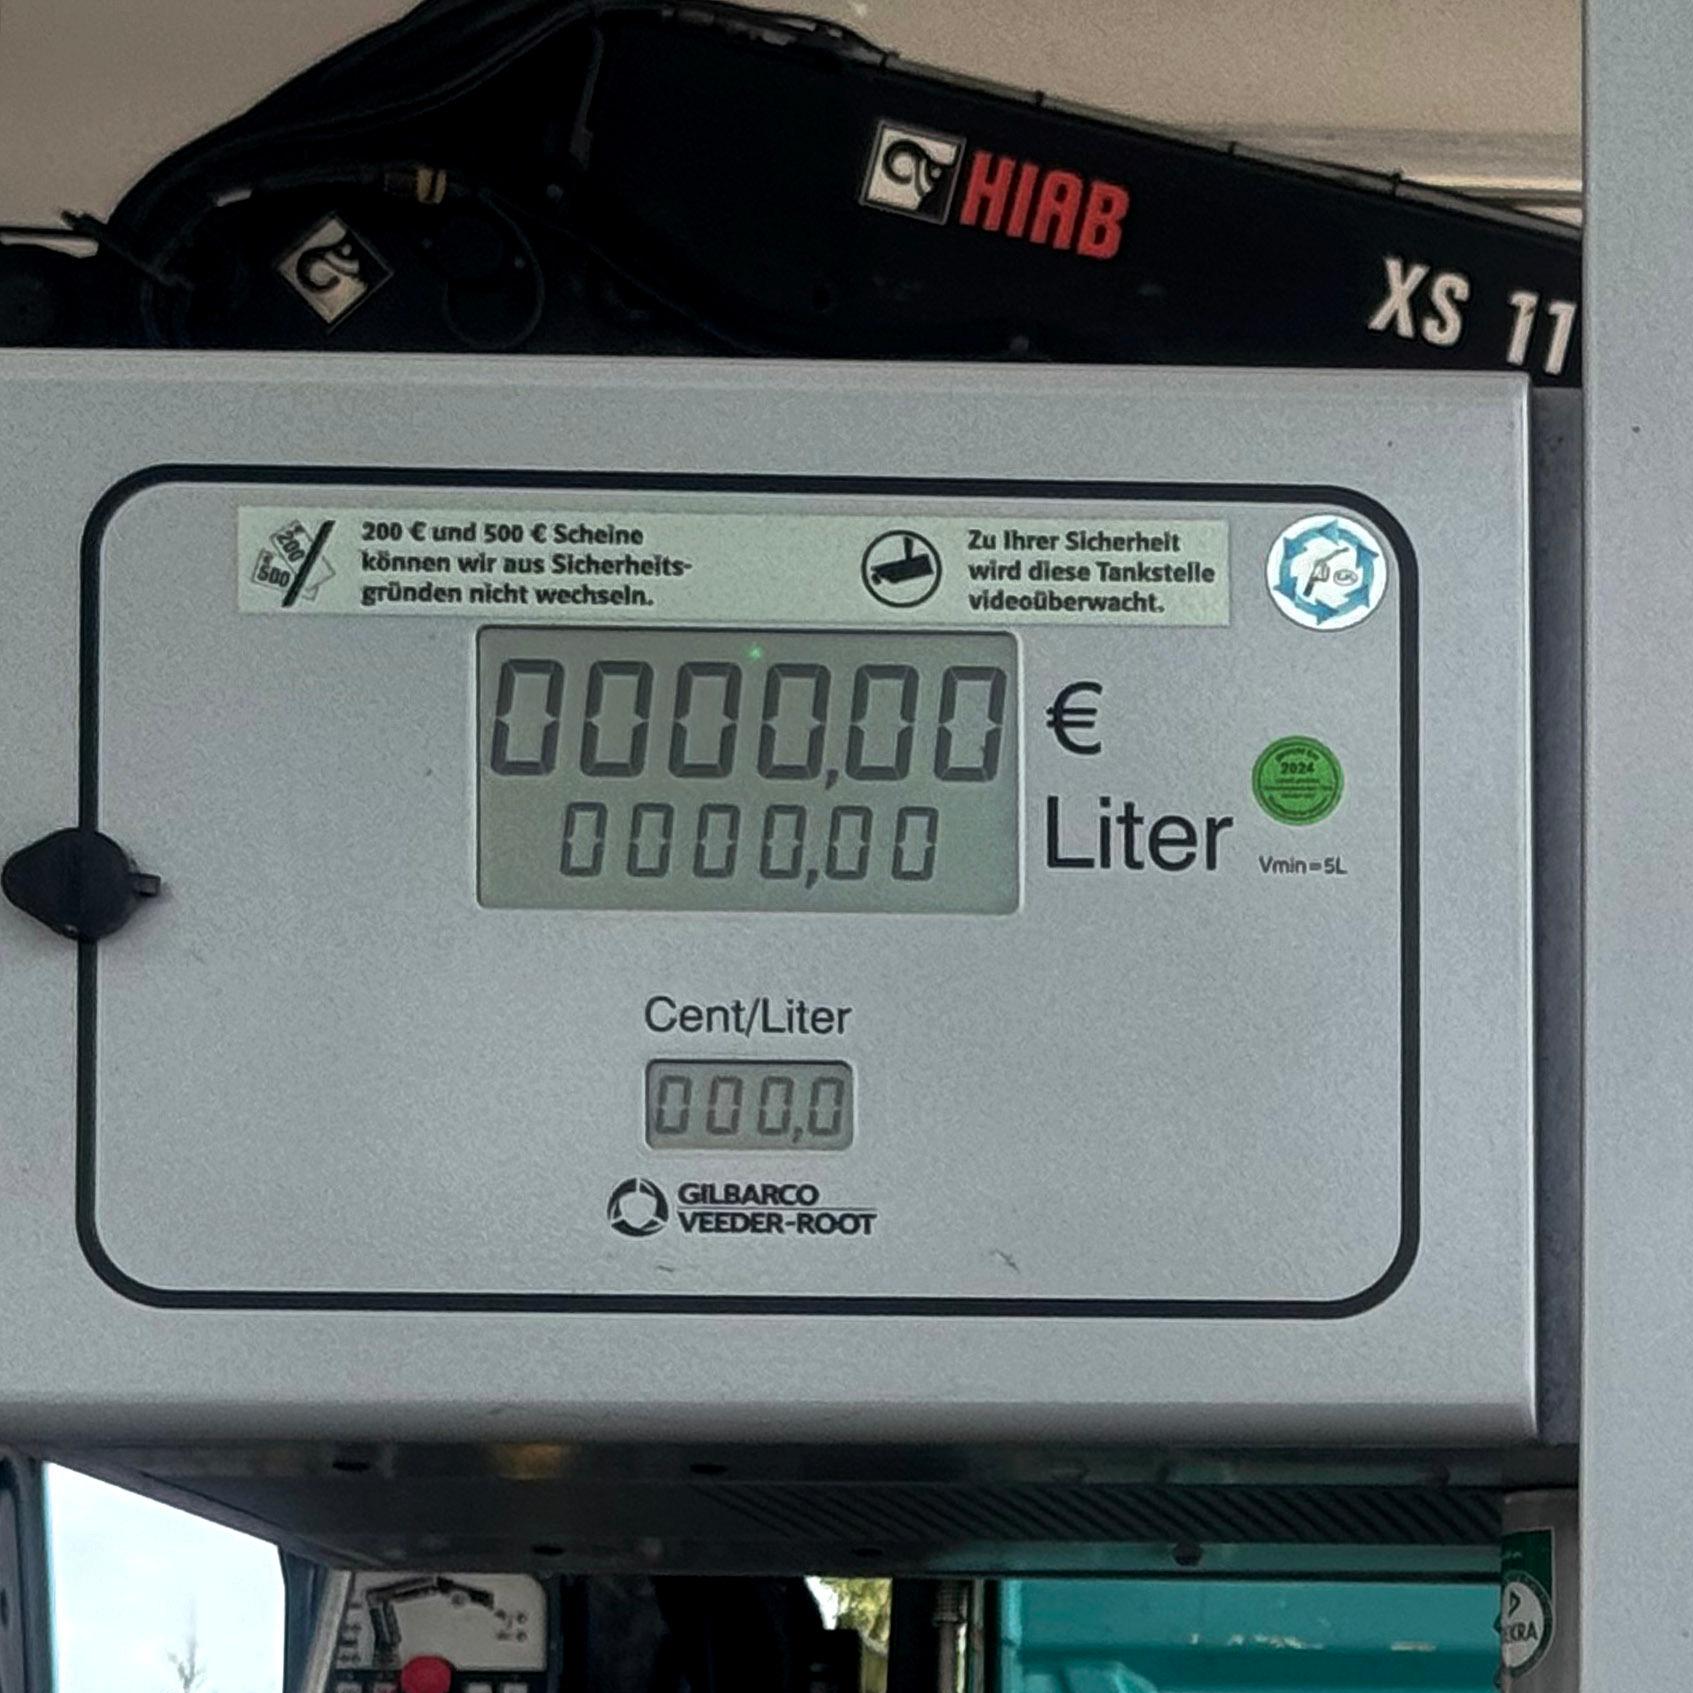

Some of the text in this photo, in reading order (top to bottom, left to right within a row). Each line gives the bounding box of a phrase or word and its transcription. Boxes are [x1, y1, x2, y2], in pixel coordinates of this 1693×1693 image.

[959, 149, 1130, 260] HIAB
[1368, 256, 1577, 375] XS 11
[362, 520, 644, 546] 200 € und 500 € Scheine
[968, 529, 1181, 552] Zu Ihrer Sicherheit
[361, 549, 693, 577] können wir aus Sicherheits-
[968, 558, 1216, 584] wird diese Tankstelle
[361, 580, 654, 606] gründen nicht wechseln.
[968, 589, 1165, 613] videoüberwacht.
[1045, 681, 1104, 755] €
[1280, 760, 1316, 775] 2024
[560, 800, 939, 890] 0000,00
[1046, 795, 1234, 871] Liter
[645, 995, 853, 1037] Cent/Liter
[655, 1074, 845, 1144] 000,0
[677, 1182, 820, 1206] GILBARCO
[677, 1211, 878, 1236] VEEDER-ROOT
[1502, 1620, 1539, 1641] KRA
